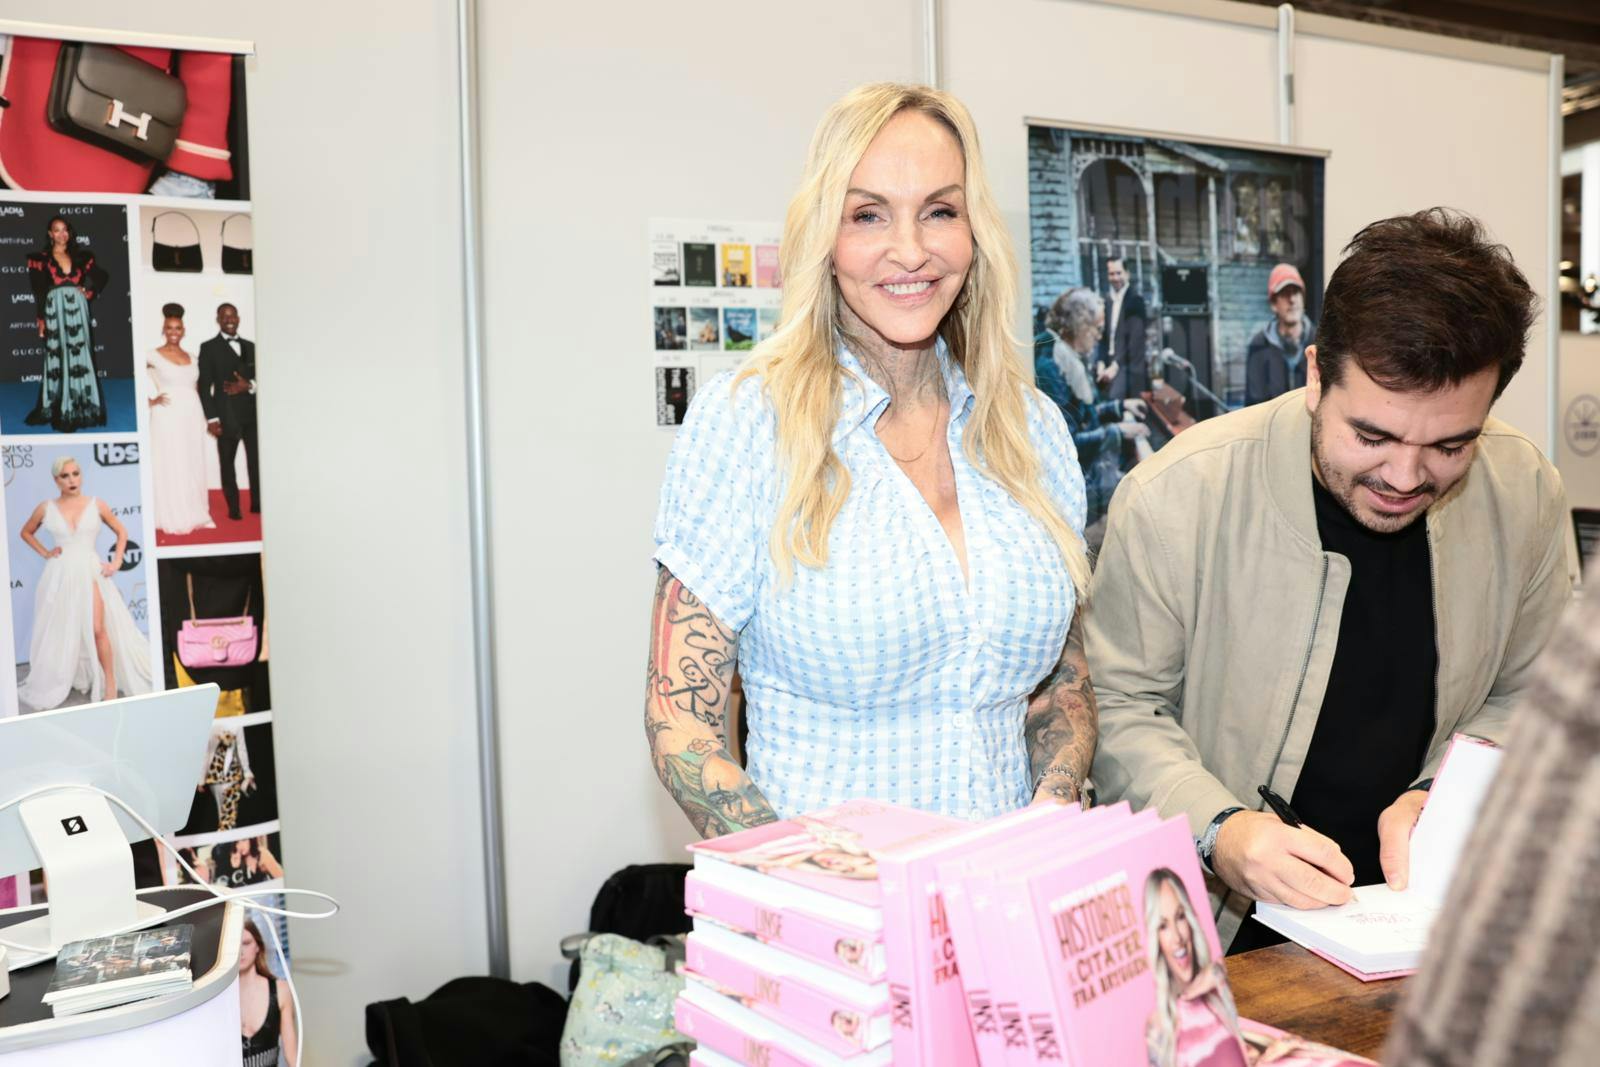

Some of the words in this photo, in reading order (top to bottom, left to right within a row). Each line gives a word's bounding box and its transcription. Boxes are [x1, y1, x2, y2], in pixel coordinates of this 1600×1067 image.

[60, 206, 94, 214] GUCCI
[12, 294, 35, 303] LACMA
[96, 443, 139, 463] tbs
[755, 906, 782, 939] LINSE
[1053, 883, 1137, 960] HISTORIER
[1076, 930, 1142, 983] CITATER
[889, 982, 912, 1031] LINSE
[967, 990, 998, 1033] LINSE
[1073, 984, 1096, 1008] FRA
[997, 1003, 1028, 1047] LINSE
[1028, 1014, 1061, 1060] LINSE
